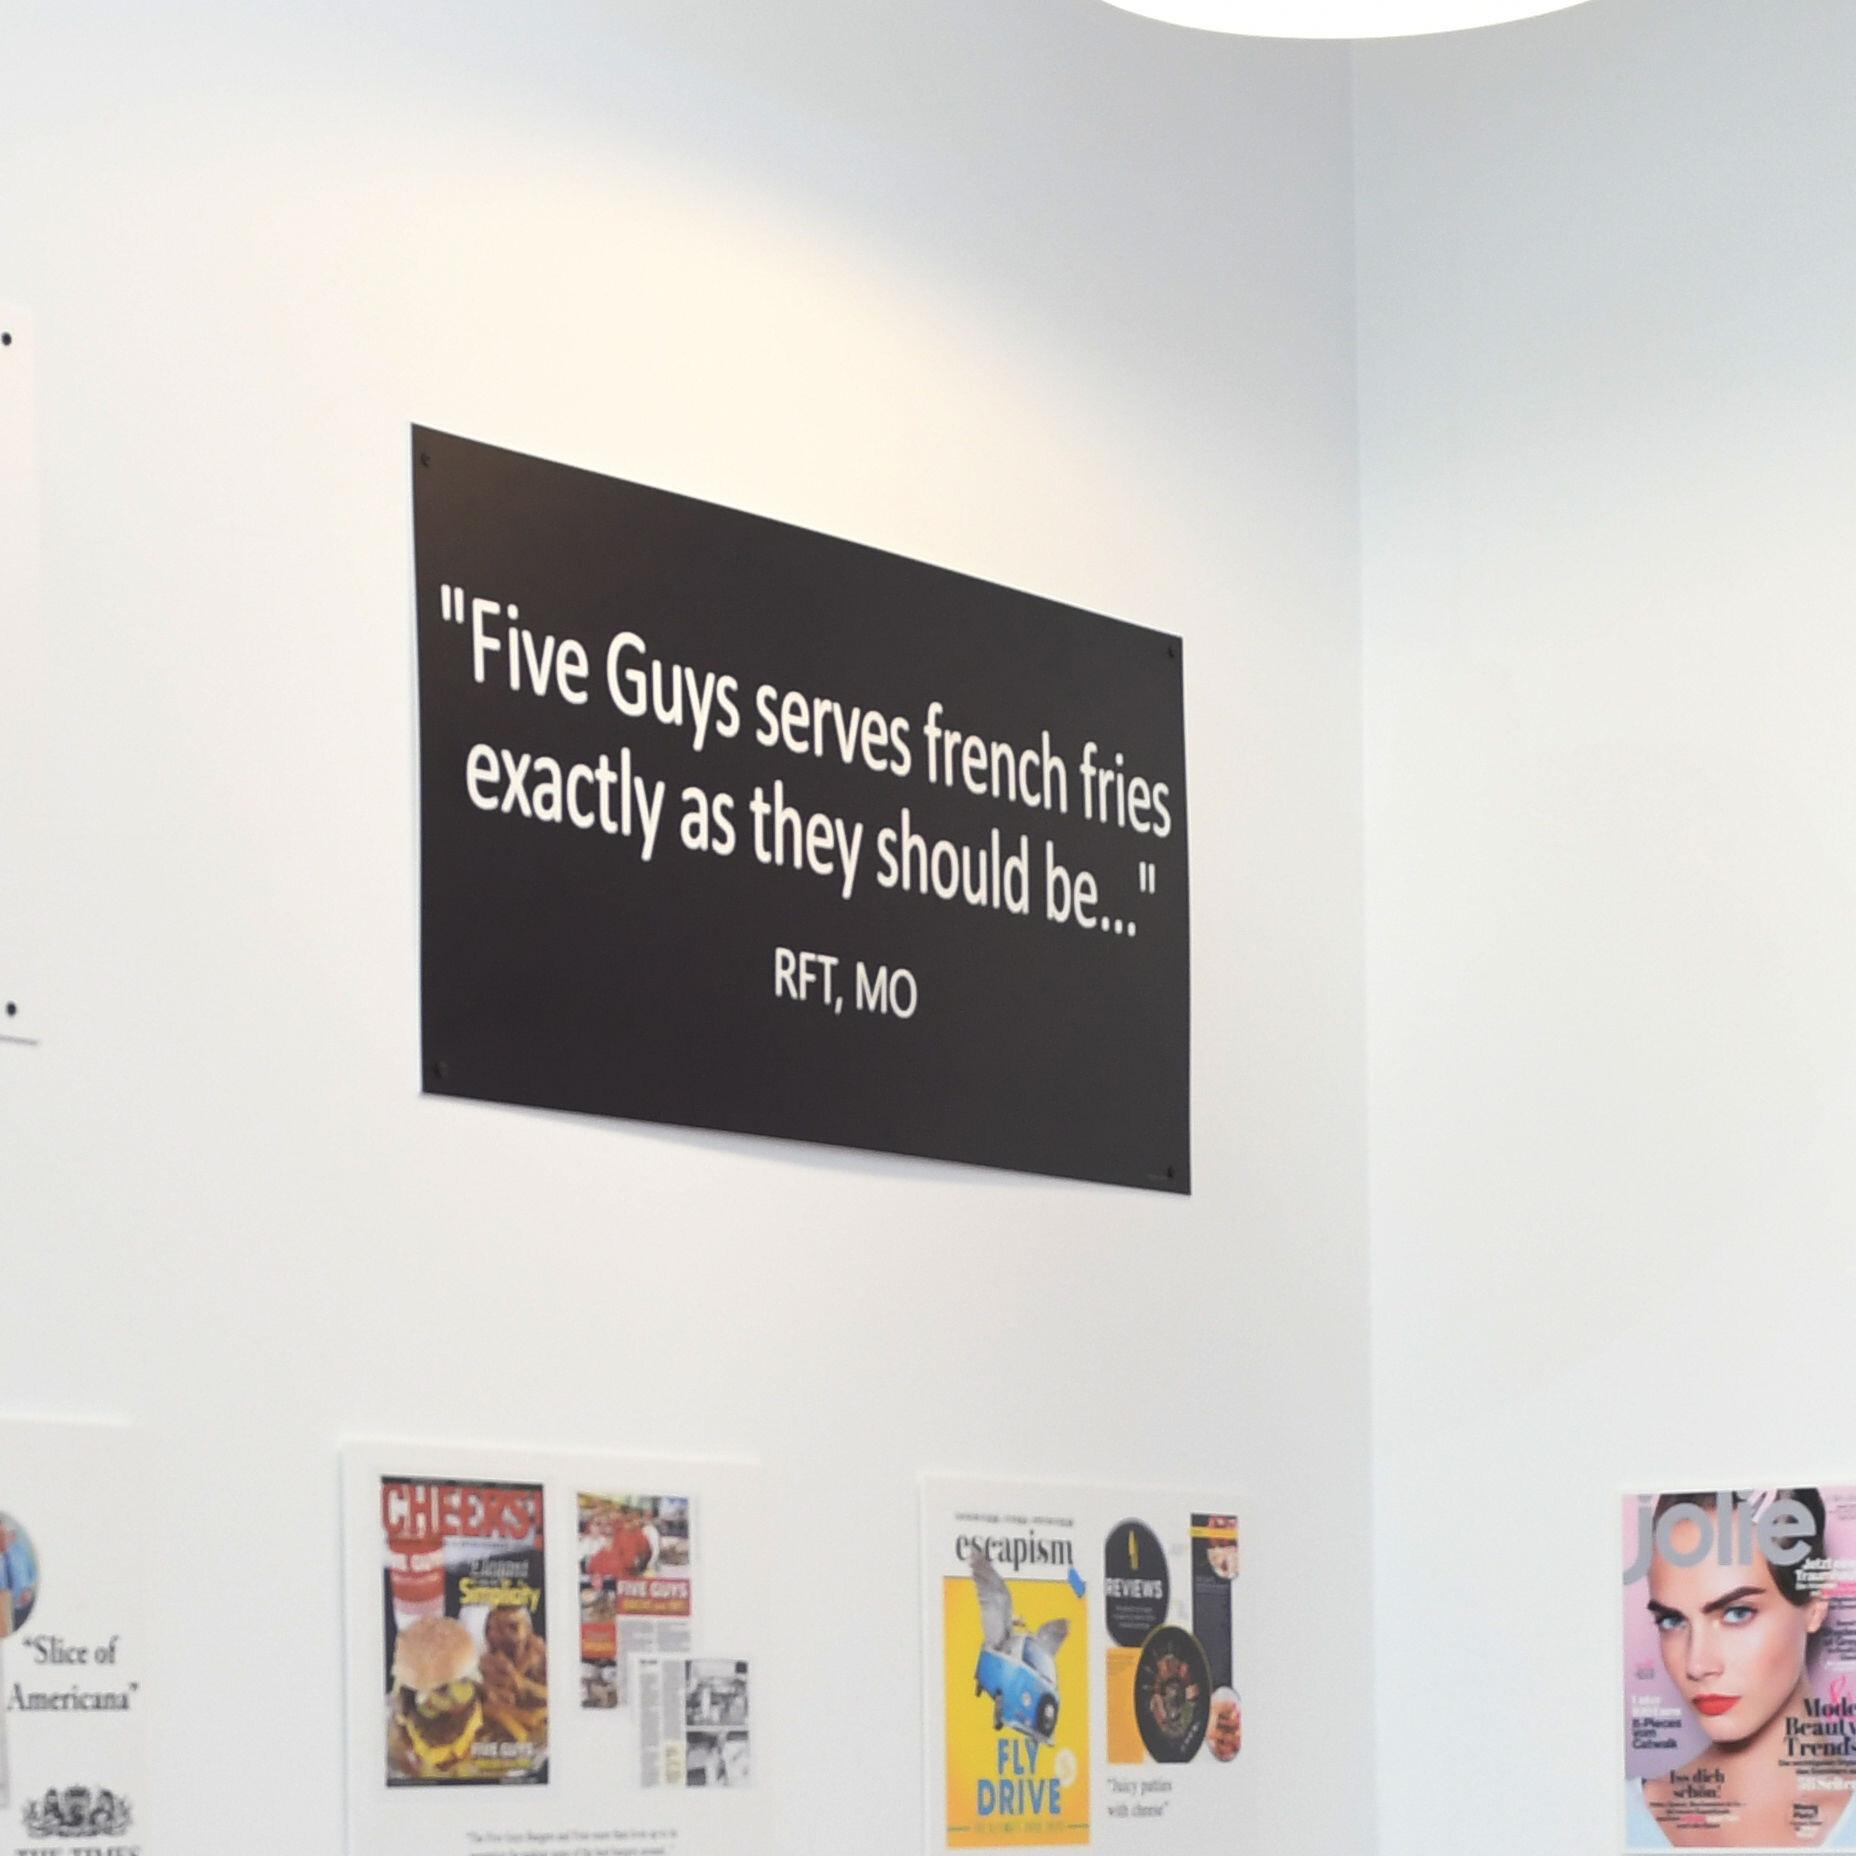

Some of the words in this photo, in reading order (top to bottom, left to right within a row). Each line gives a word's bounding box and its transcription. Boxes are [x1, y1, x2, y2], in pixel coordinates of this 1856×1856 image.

[439, 582, 590, 706] "Five
[605, 630, 741, 753] Guys
[754, 683, 913, 778] serves
[922, 700, 1068, 815] french
[1079, 740, 1173, 839] fries
[465, 742, 667, 863] exactly
[679, 785, 737, 857] as
[748, 778, 865, 901] they
[875, 806, 1031, 916] should
[1044, 839, 1157, 938] be..."
[774, 946, 844, 1015] RFT,
[855, 960, 919, 1020] MO
[955, 1528, 1074, 1572] escapism
[1622, 1489, 1817, 1586] jolie
[617, 1580, 648, 1597] FIVE
[650, 1580, 689, 1599] GUYS
[1103, 1576, 1163, 1600] REVIEWS
[93, 1633, 120, 1664] of
[1785, 1716, 1856, 1737] Beauty
[997, 1738, 1041, 1775] FLY
[976, 1778, 1062, 1817] DRIVE
